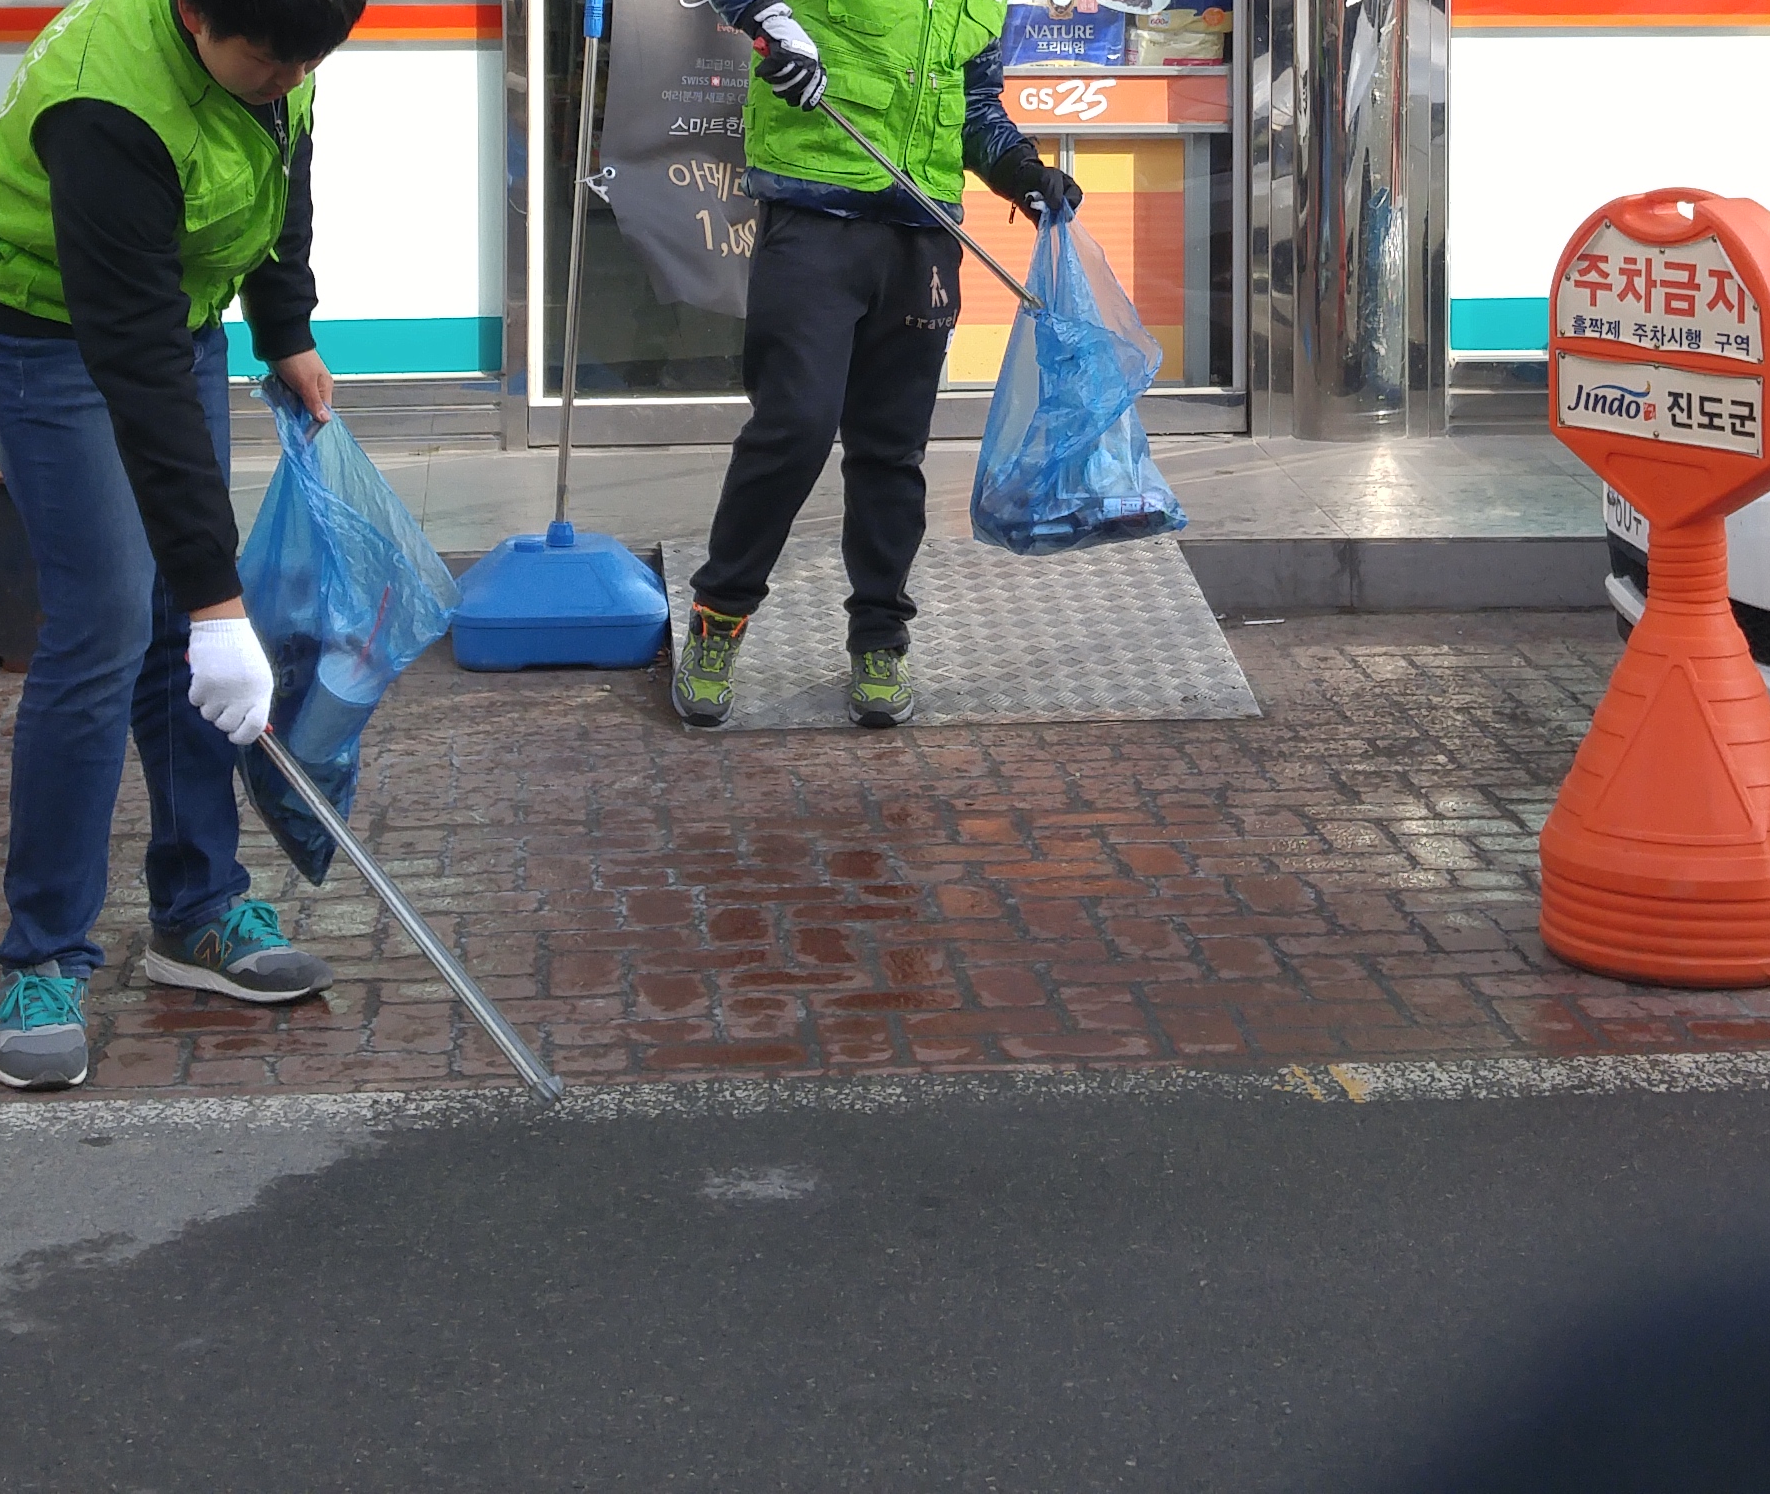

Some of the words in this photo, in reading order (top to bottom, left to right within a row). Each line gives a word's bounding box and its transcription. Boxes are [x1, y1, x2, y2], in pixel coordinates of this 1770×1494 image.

[1025, 24, 1095, 39] NATURE
[1035, 40, 1086, 55] 프리미엄
[694, 57, 734, 72] 최고급의
[737, 60, 751, 72] 스
[681, 75, 710, 86] SWISS
[721, 77, 750, 89] MADE
[661, 90, 703, 104] 여러분께
[705, 92, 737, 105] 새로운
[1019, 78, 1118, 121] GS25
[668, 116, 746, 138] 스마트한
[1573, 253, 1748, 325] 주차금지
[904, 308, 958, 330] travel
[1571, 314, 1621, 340] 홀짝제
[1632, 322, 1702, 350] 주차시행
[1714, 331, 1751, 356] 구역
[1567, 383, 1642, 421] Jindo
[1666, 389, 1757, 439] 진도군
